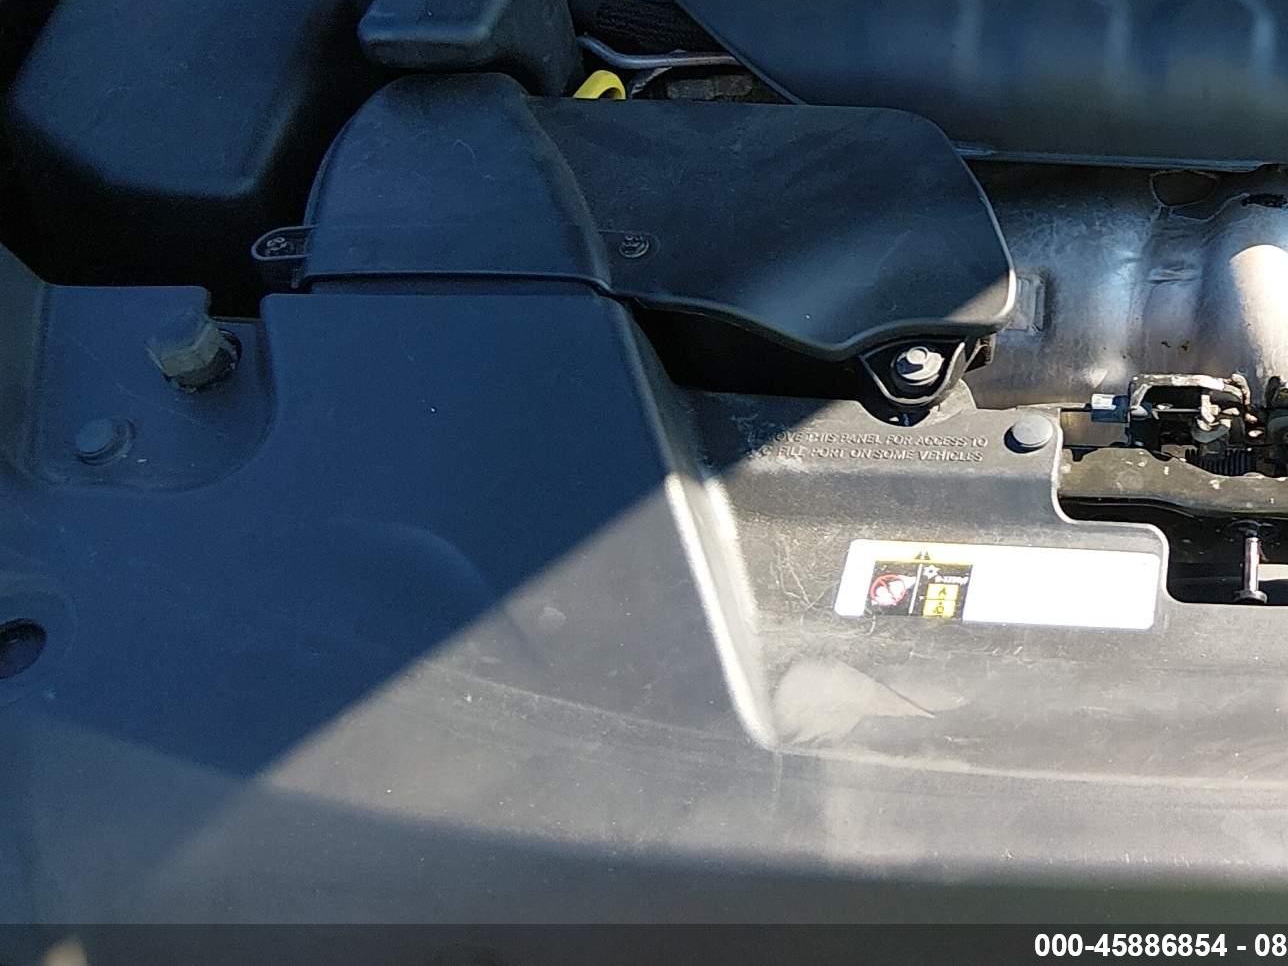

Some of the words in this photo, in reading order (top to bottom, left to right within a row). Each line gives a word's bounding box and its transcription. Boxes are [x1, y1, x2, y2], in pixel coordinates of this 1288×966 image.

[747, 431, 802, 444] REOVE
[804, 432, 838, 444] THIS
[839, 433, 883, 445] PANEL
[885, 434, 913, 446] FOR
[916, 434, 968, 447] ACCESS
[970, 436, 989, 448] TO
[811, 446, 846, 458] PORT
[849, 447, 872, 459] ON
[872, 448, 914, 460] SOME
[917, 449, 984, 462] VEHICLES
